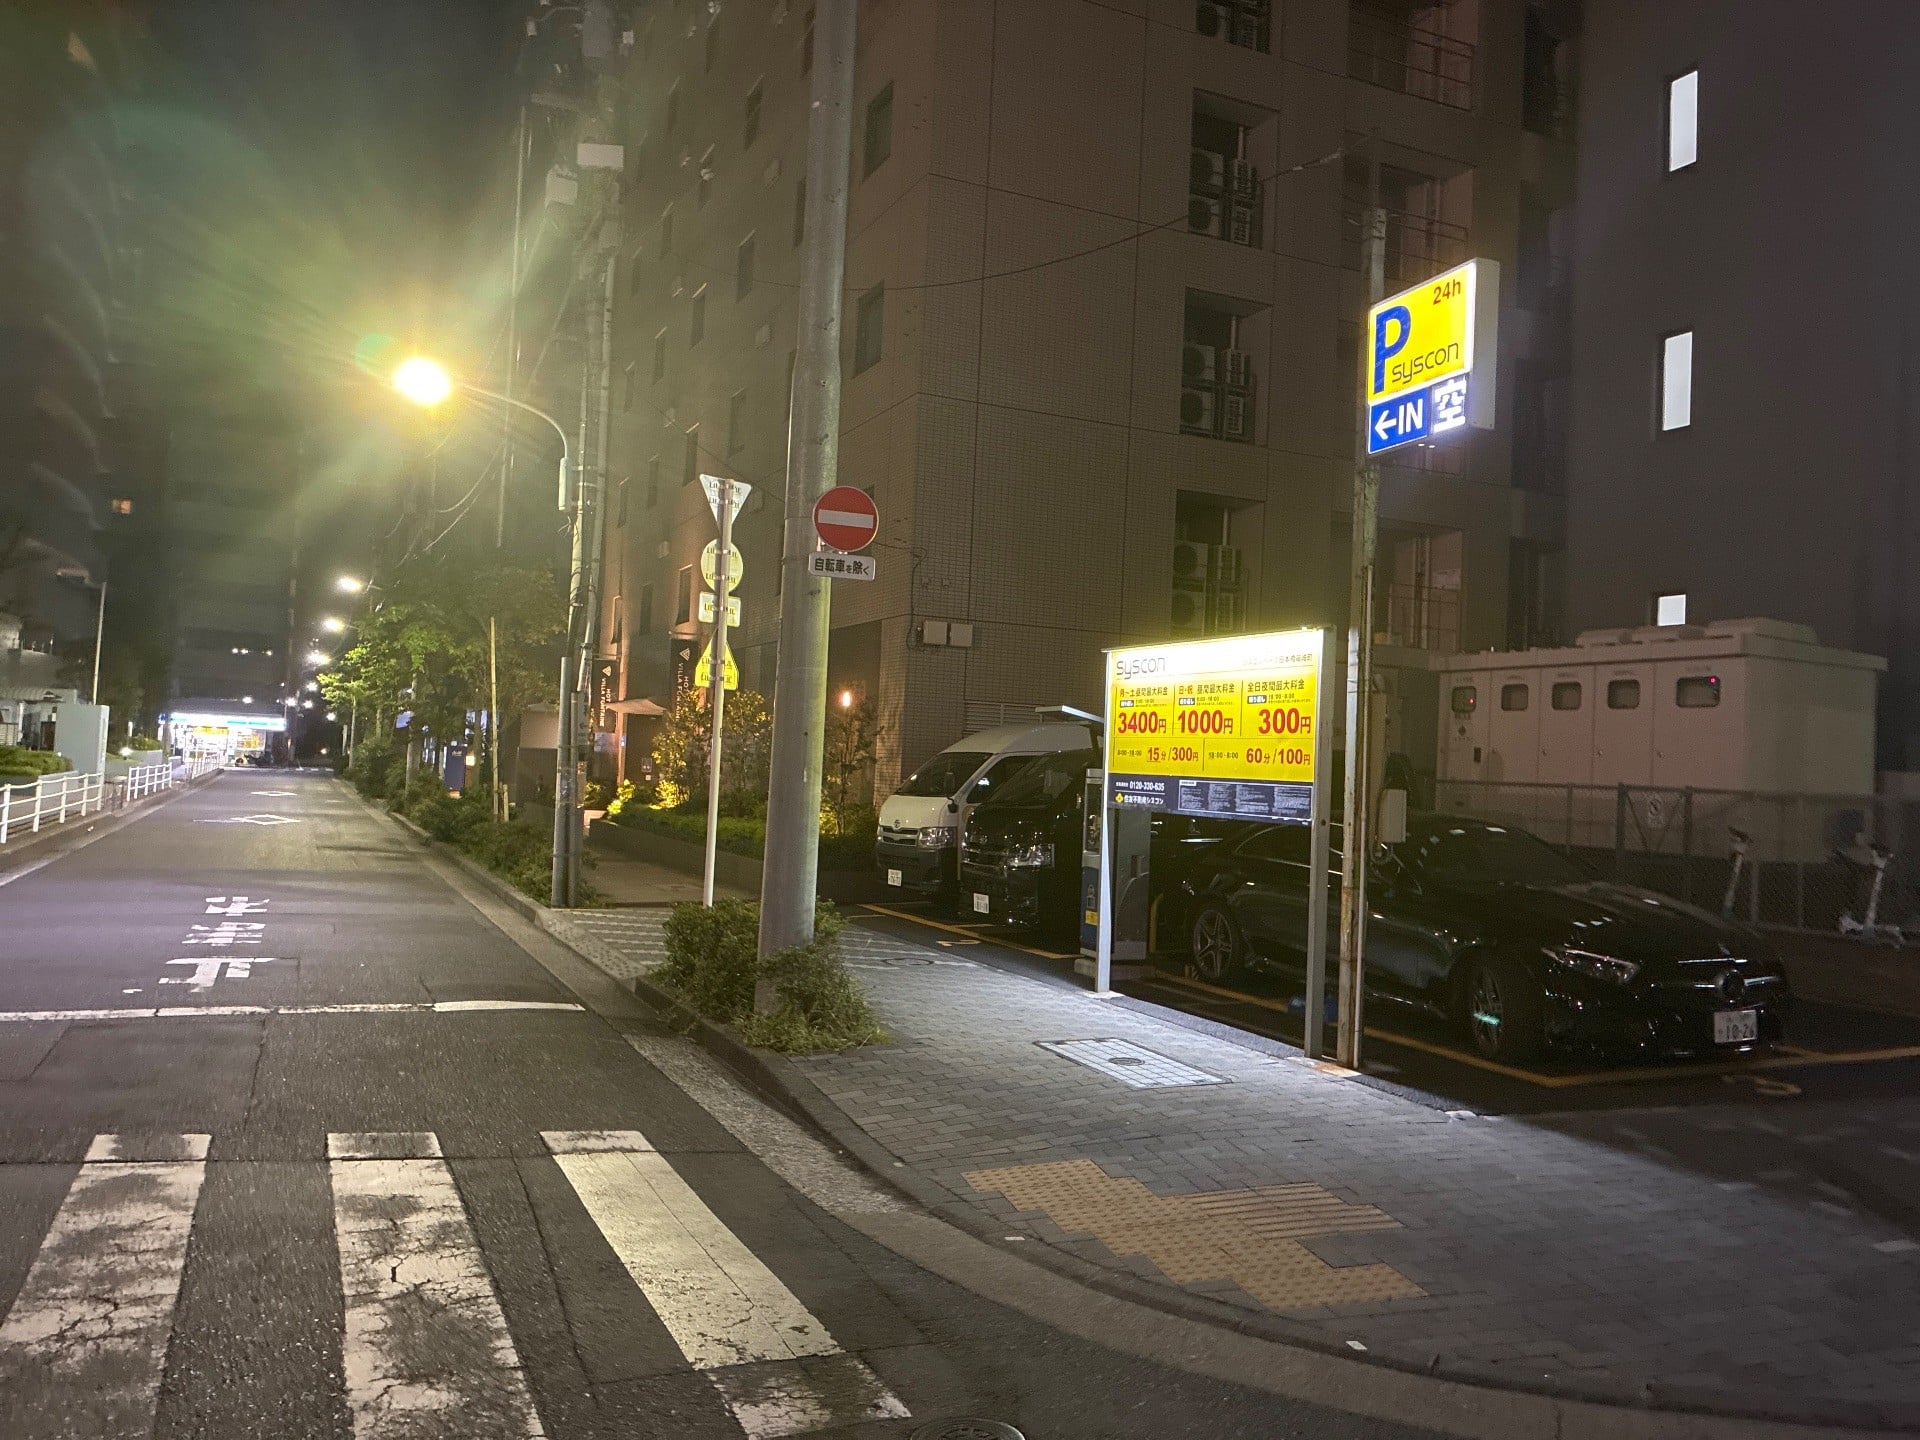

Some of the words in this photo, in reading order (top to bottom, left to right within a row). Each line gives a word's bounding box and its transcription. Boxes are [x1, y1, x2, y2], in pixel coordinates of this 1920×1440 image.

[1433, 279, 1461, 305] 24h
[1373, 305, 1411, 395] P
[1392, 342, 1459, 384] syscon
[1397, 398, 1423, 435] IN
[1433, 376, 1466, 434] 空
[814, 557, 870, 577] 自転車を除く
[1116, 657, 1166, 680] syscon
[1247, 678, 1305, 692] 全日夜間最大料金
[1118, 711, 1167, 735] 3400円
[1178, 709, 1233, 735] 1000円
[1258, 707, 1311, 735] 300円
